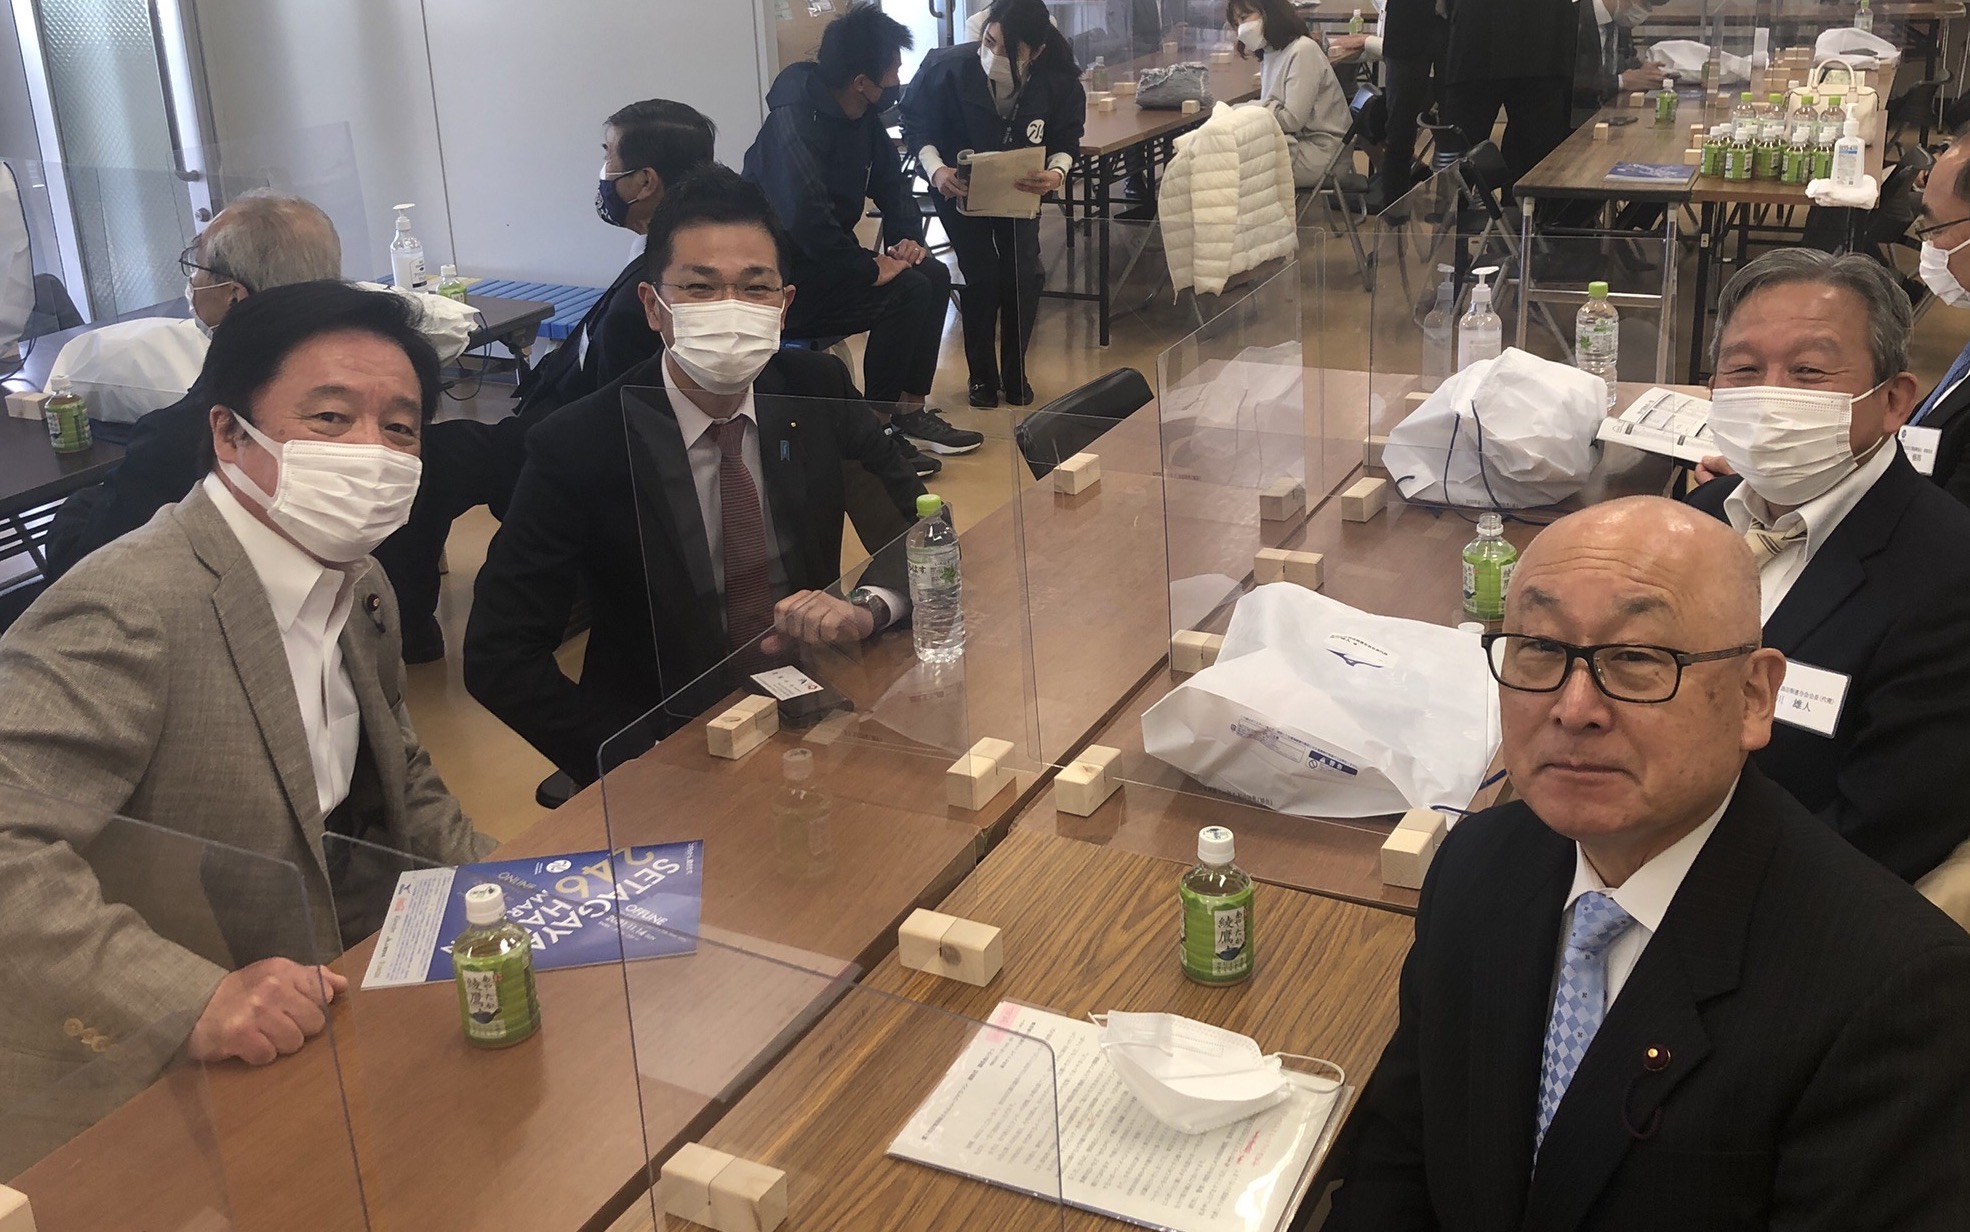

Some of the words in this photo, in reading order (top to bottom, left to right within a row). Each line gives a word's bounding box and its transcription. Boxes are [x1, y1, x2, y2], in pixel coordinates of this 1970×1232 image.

[497, 871, 537, 890] ONLINE
[555, 846, 655, 899] 246
[625, 903, 669, 926] OFFLINE
[1217, 915, 1235, 945] 綾鷹
